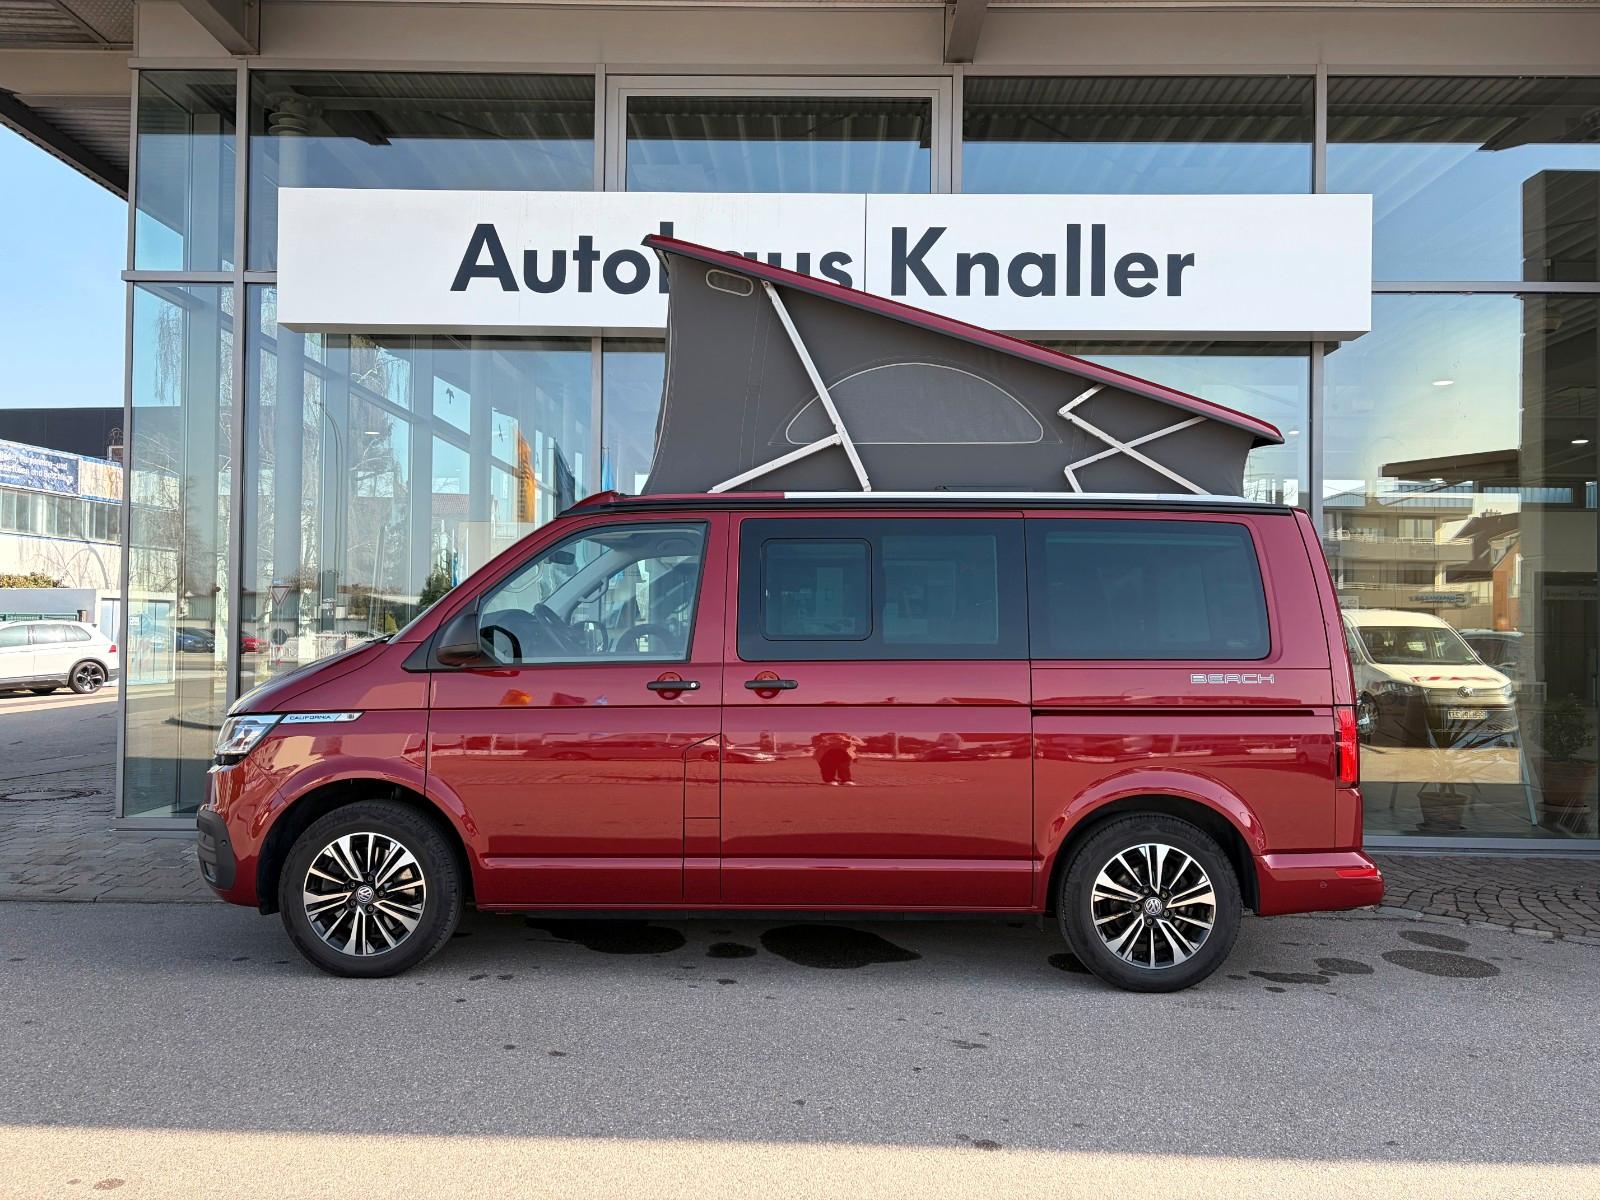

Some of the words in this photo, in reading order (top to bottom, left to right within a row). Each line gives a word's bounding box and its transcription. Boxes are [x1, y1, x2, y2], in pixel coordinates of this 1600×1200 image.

[450, 221, 854, 295] Autos
[890, 223, 1195, 298] Knaller
[1190, 673, 1275, 684] BEACH
